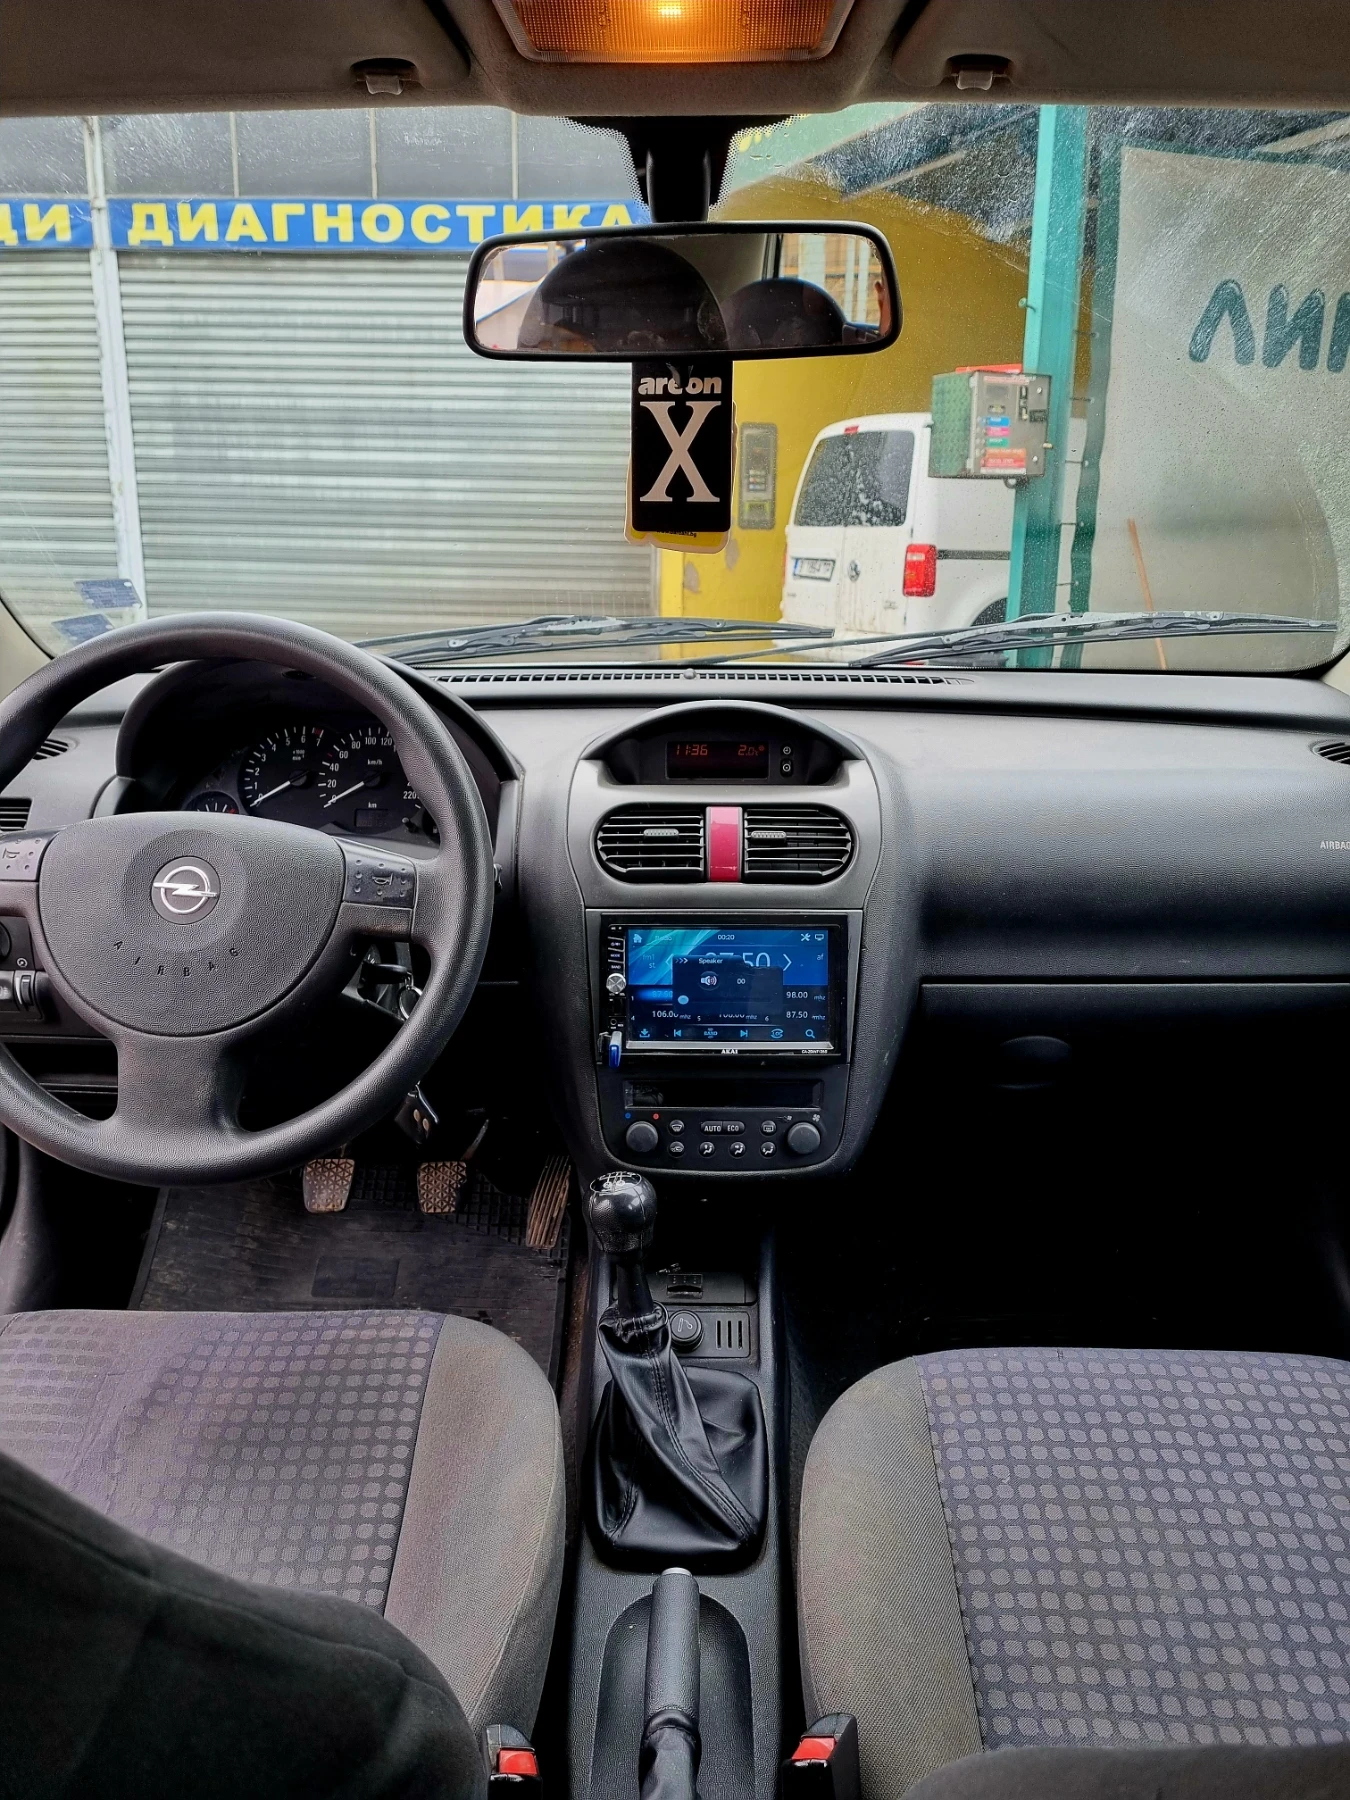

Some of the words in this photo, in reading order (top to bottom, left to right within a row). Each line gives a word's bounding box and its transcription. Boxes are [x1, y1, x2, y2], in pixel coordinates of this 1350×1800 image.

[640, 401, 722, 502] X
[351, 741, 361, 749] 80
[365, 737, 377, 745] 100
[381, 737, 393, 746] 120
[339, 750, 349, 759] 60
[676, 744, 708, 756] 11:36
[261, 753, 266, 762] 3
[255, 767, 260, 776] 2
[329, 763, 339, 772] 40
[327, 780, 337, 788] 20
[403, 791, 417, 799] 220
[786, 991, 808, 999] 98.00
[786, 1011, 808, 1019] 87.50
[703, 1124, 722, 1132] AUTO
[727, 1123, 739, 1132] ECO
